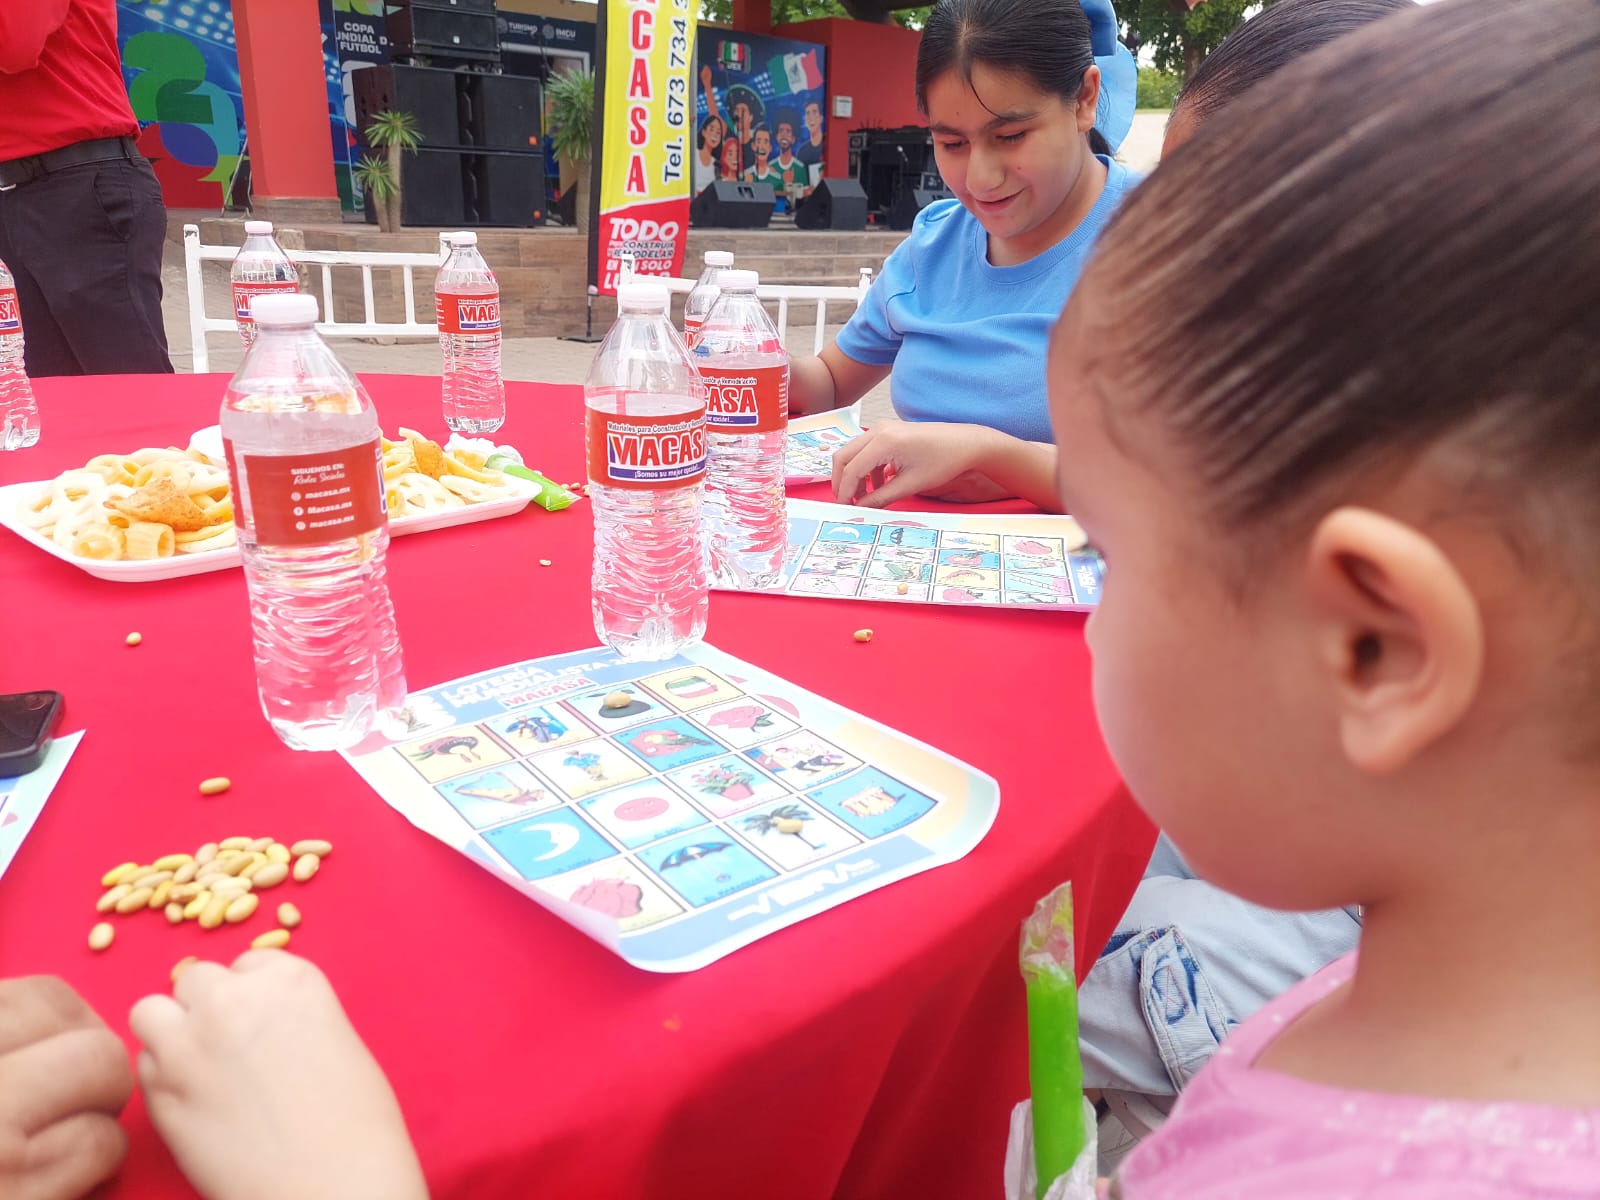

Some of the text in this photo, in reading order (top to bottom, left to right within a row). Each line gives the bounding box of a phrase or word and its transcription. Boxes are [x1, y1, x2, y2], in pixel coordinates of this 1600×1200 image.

[343, 22, 375, 34] COPA
[670, 19, 687, 67] 734
[340, 41, 382, 54] FUTBOL
[627, 0, 656, 193] CASA
[667, 79, 686, 126] 673
[664, 137, 683, 182] Tel.
[609, 217, 680, 241] TODO
[640, 259, 672, 271] SOLO
[607, 421, 636, 433] Materiales
[637, 426, 652, 434] para
[607, 428, 706, 467] MACAS
